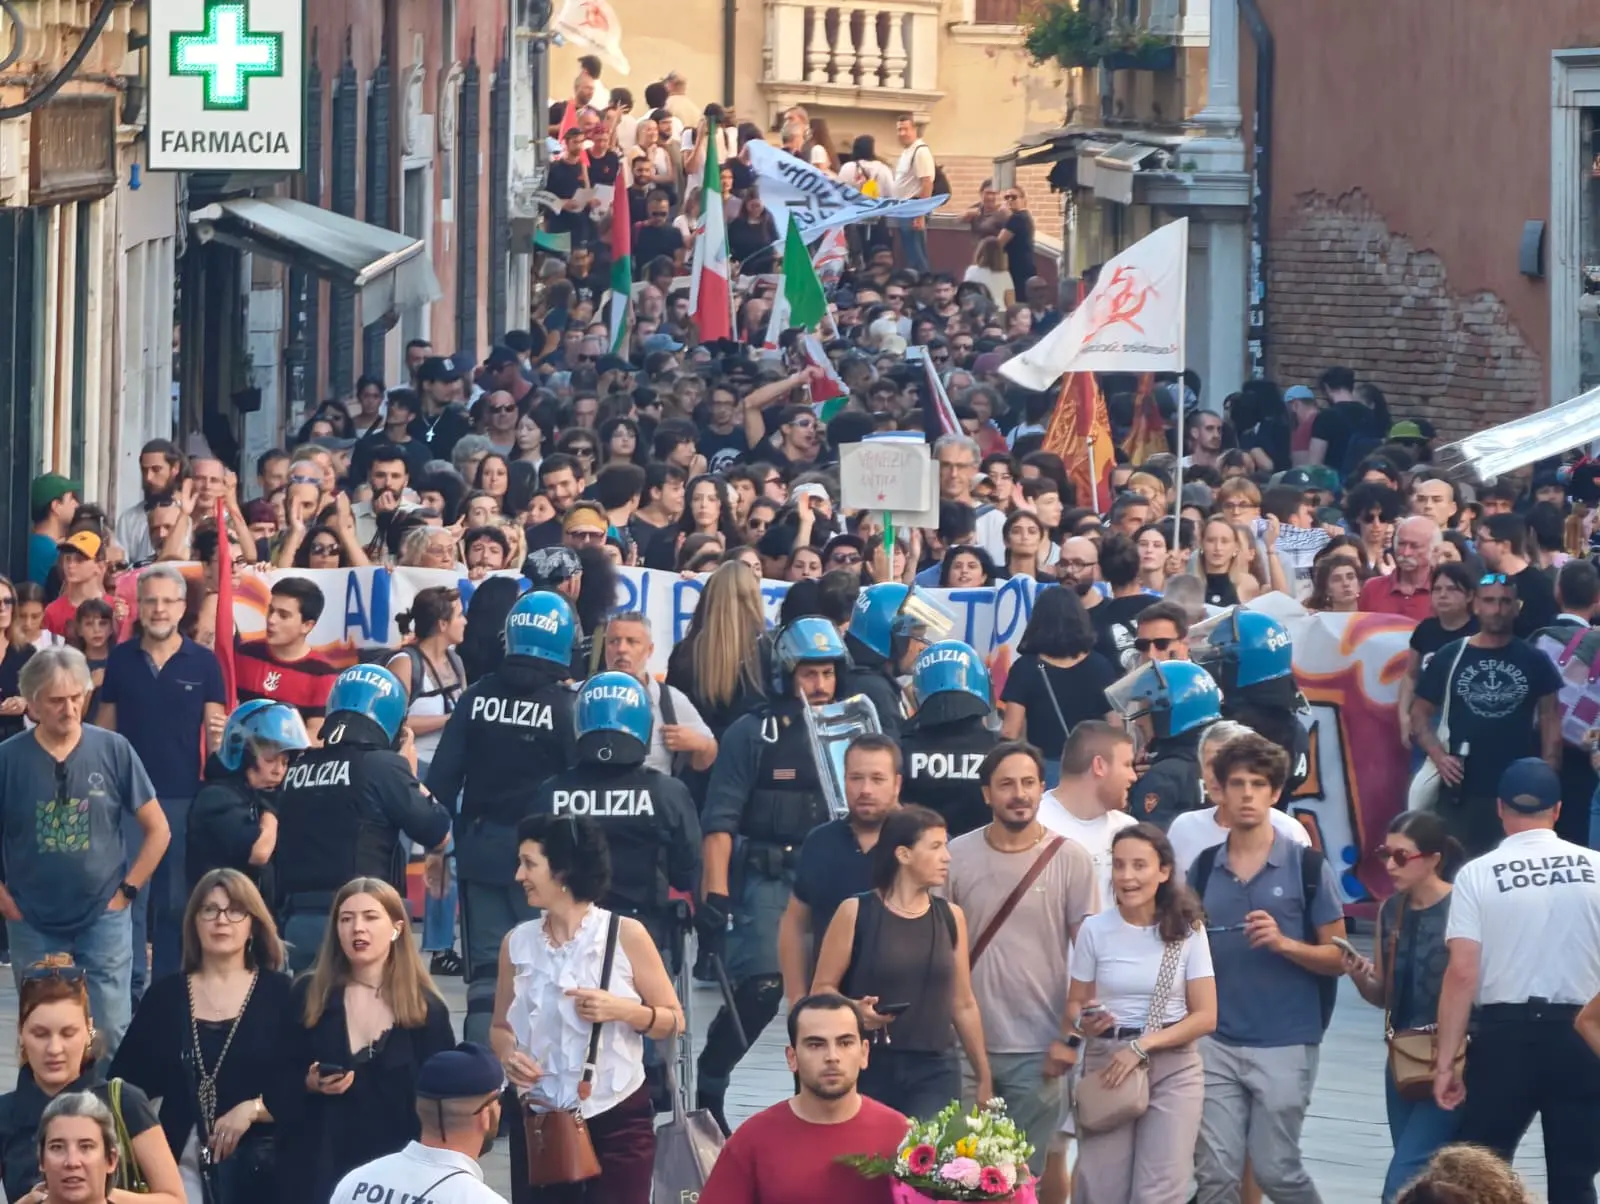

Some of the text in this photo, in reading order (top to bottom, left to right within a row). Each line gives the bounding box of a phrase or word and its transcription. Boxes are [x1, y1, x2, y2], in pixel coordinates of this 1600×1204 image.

[161, 130, 290, 154] FARMACIA
[511, 612, 559, 635] POLIZIA
[915, 649, 970, 676] POLIZIA
[338, 670, 393, 696] POLIZIA
[584, 685, 640, 707] POLIZIA
[471, 696, 554, 730] POLIZIA
[283, 759, 351, 791] POLIZIA
[911, 753, 987, 779] POLIZ
[552, 789, 655, 816] POLIZIA
[1492, 854, 1592, 877] POLIZIA
[1497, 869, 1596, 893] LOCALE
